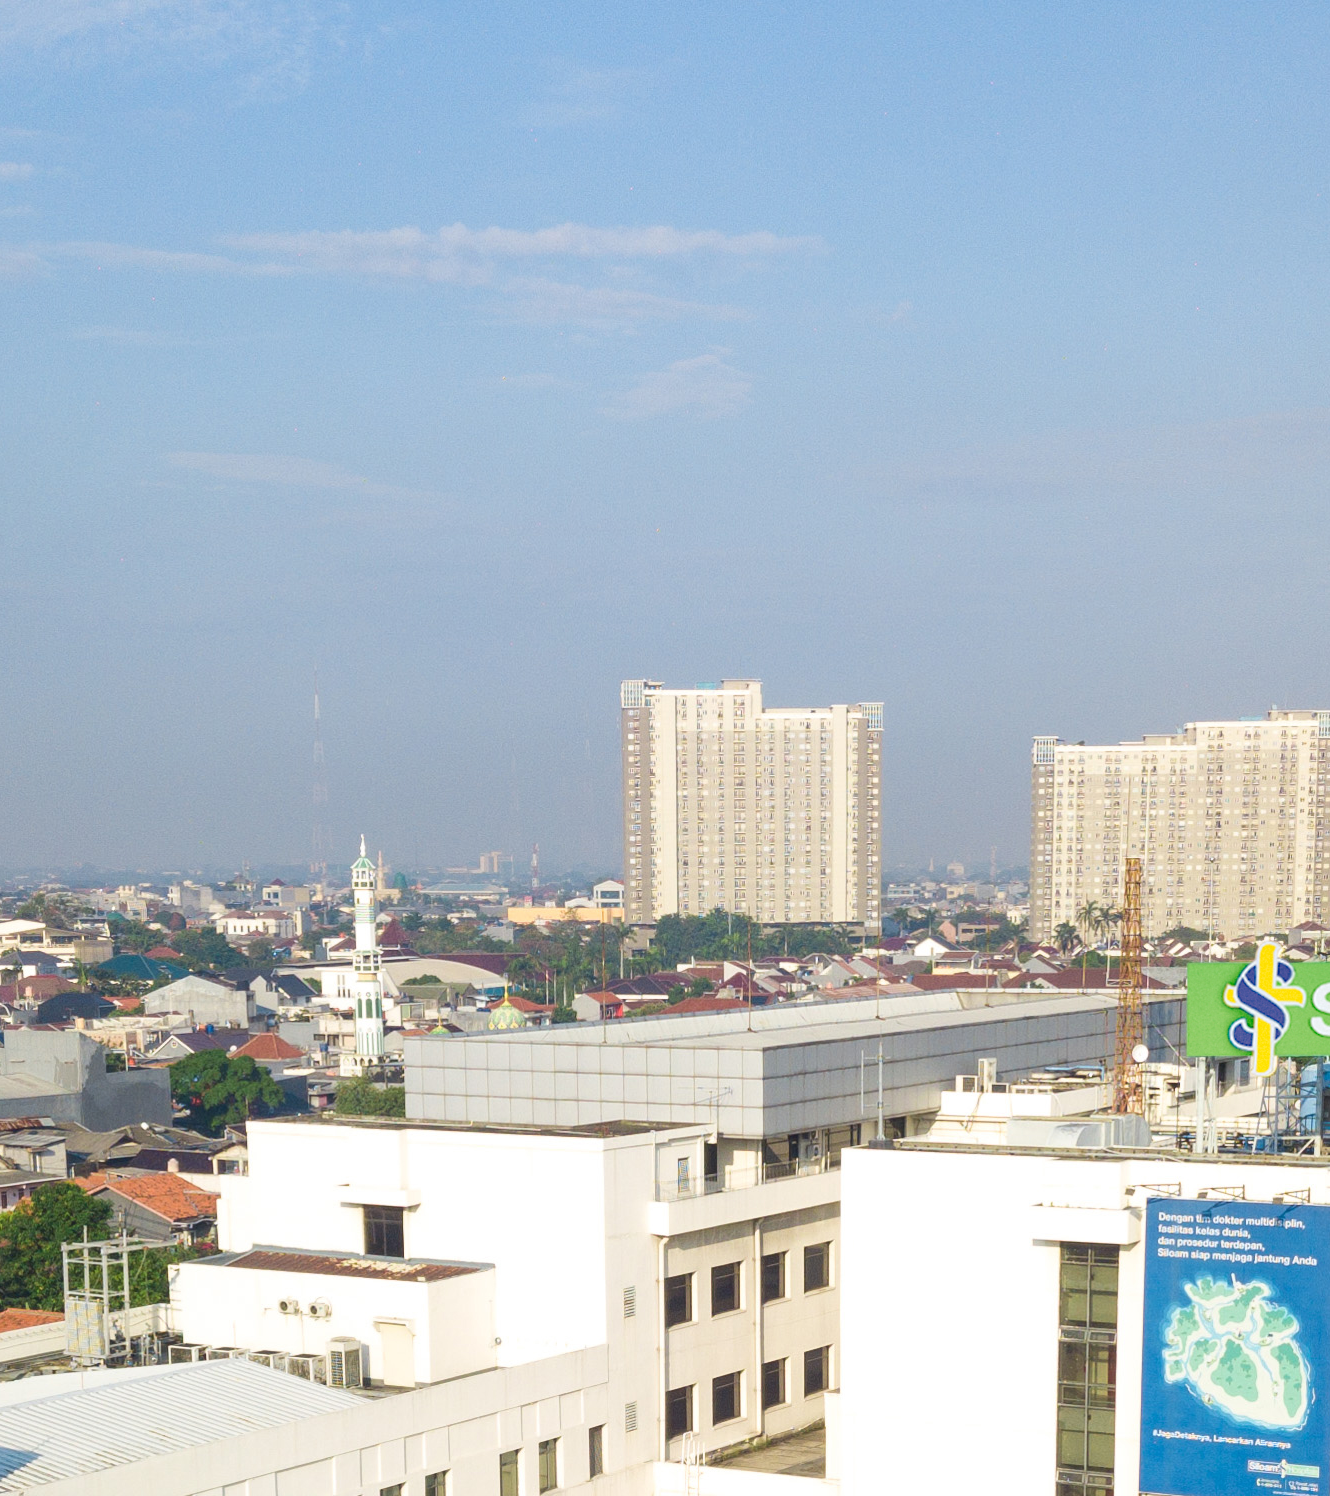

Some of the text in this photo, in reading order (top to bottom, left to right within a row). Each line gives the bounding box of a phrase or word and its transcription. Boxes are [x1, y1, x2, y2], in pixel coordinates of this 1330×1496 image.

[1158, 1212, 1194, 1224] Dengan
[1213, 1215, 1244, 1225] dokter
[1158, 1224, 1251, 1239] fasilitas kelas dunia,
[1157, 1236, 1265, 1251] dan prosedur terdepan,
[1157, 1248, 1317, 1266] Siloam siap menjaga jantung Anda
